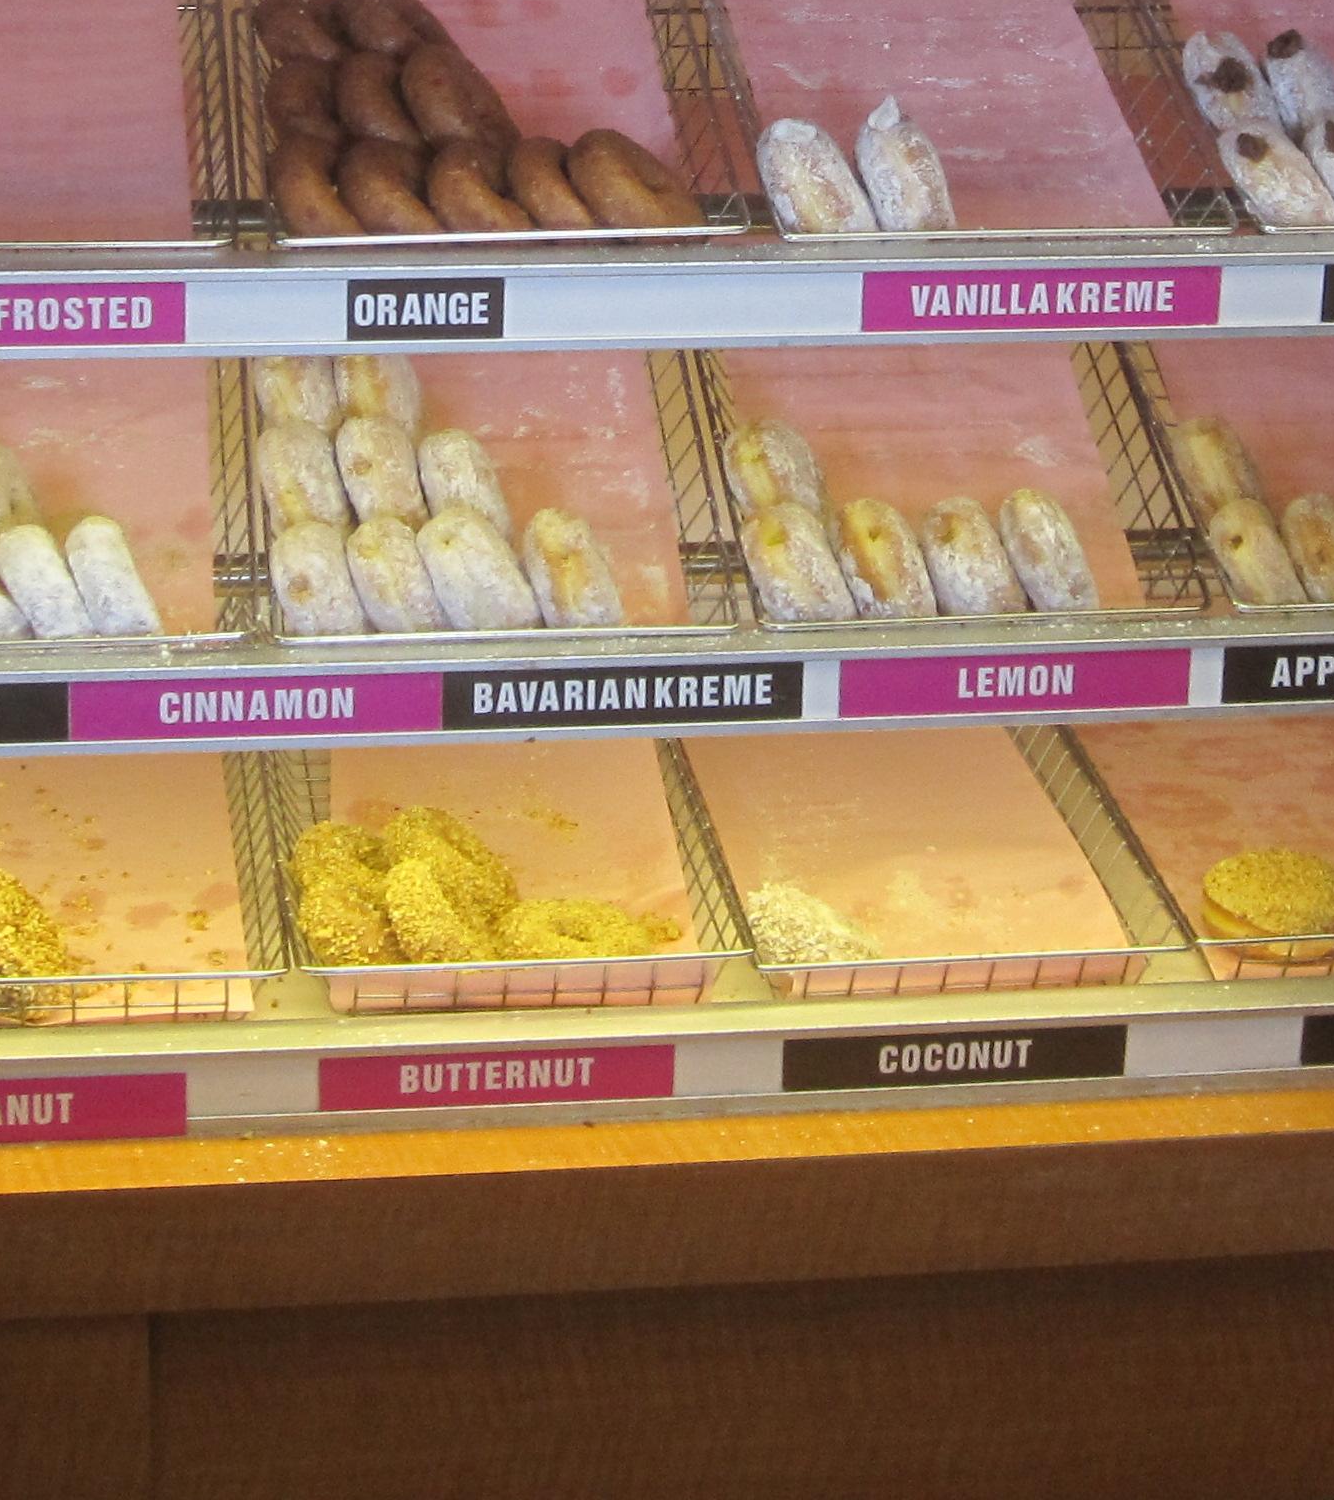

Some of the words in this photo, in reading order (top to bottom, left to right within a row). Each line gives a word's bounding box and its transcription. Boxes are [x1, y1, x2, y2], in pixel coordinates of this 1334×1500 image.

[354, 291, 490, 327] ORANGE
[910, 282, 1050, 317] VANILLA
[1055, 280, 1175, 314] KREME
[473, 677, 647, 714] BAVARIAN
[653, 673, 773, 708] KREME
[957, 664, 1074, 699] LEMON
[159, 686, 354, 725] CINNAMON
[399, 1056, 595, 1094] BUTTERNUT
[878, 1039, 1033, 1074] COCONUT
